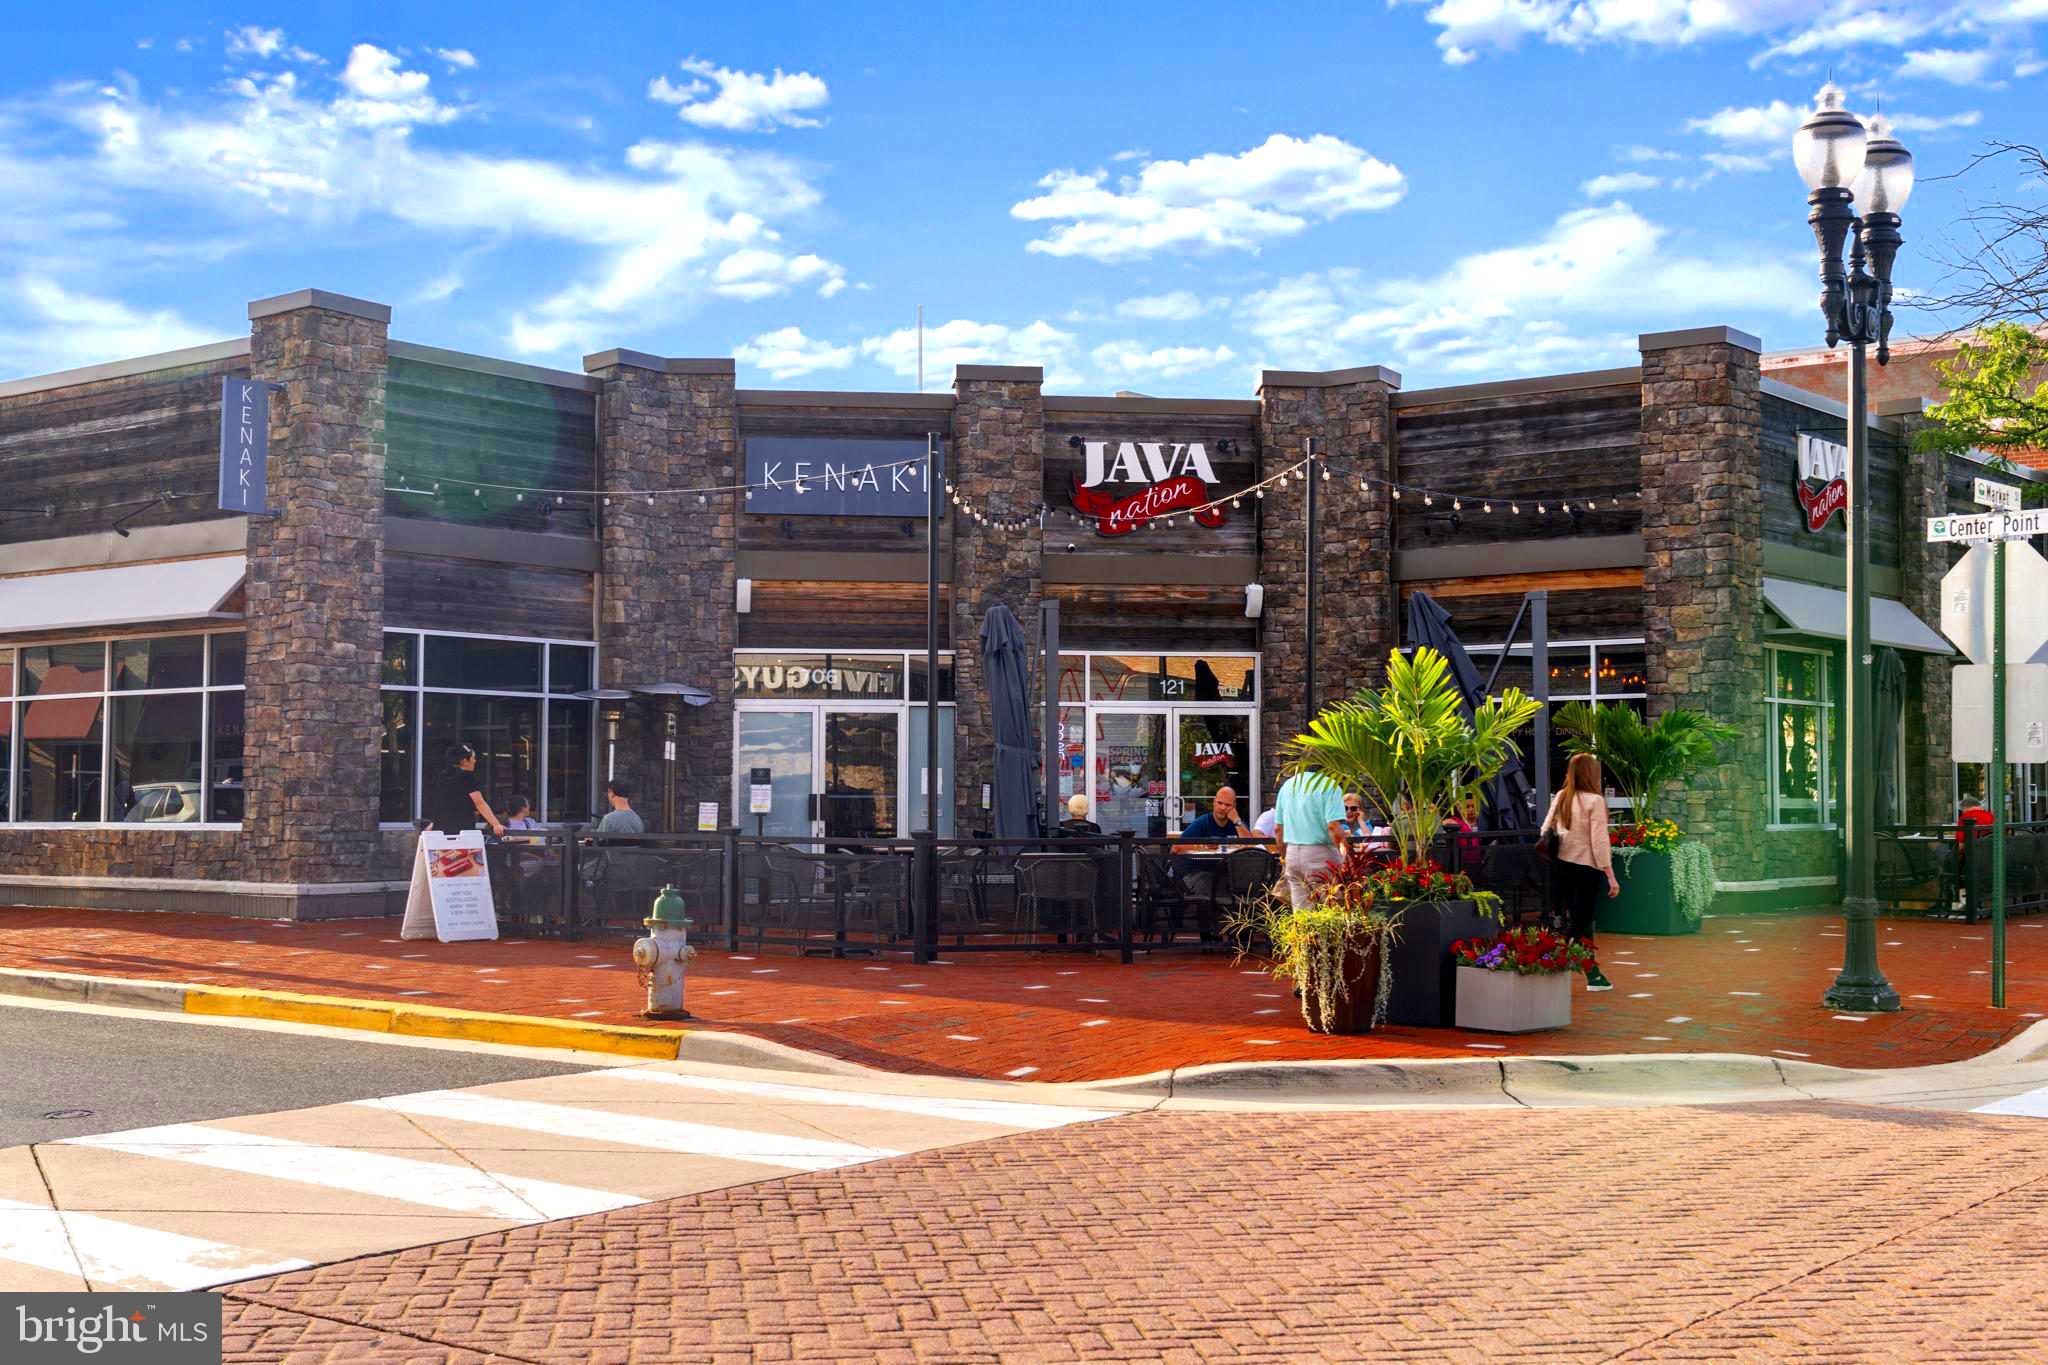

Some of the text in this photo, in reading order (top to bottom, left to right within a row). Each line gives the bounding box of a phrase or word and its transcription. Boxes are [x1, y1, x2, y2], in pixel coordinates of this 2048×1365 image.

[240, 384, 254, 506] KENAKI
[763, 461, 927, 494] KENAKI
[1081, 441, 1221, 488] JAVA
[1109, 481, 1193, 526] nation
[1812, 485, 1845, 522] nation
[1986, 485, 2010, 506] Market
[1949, 513, 2040, 537] Center Point
[1159, 679, 1184, 695] 121
[1109, 746, 1149, 756] SPRING
[1194, 742, 1234, 757] JAVA
